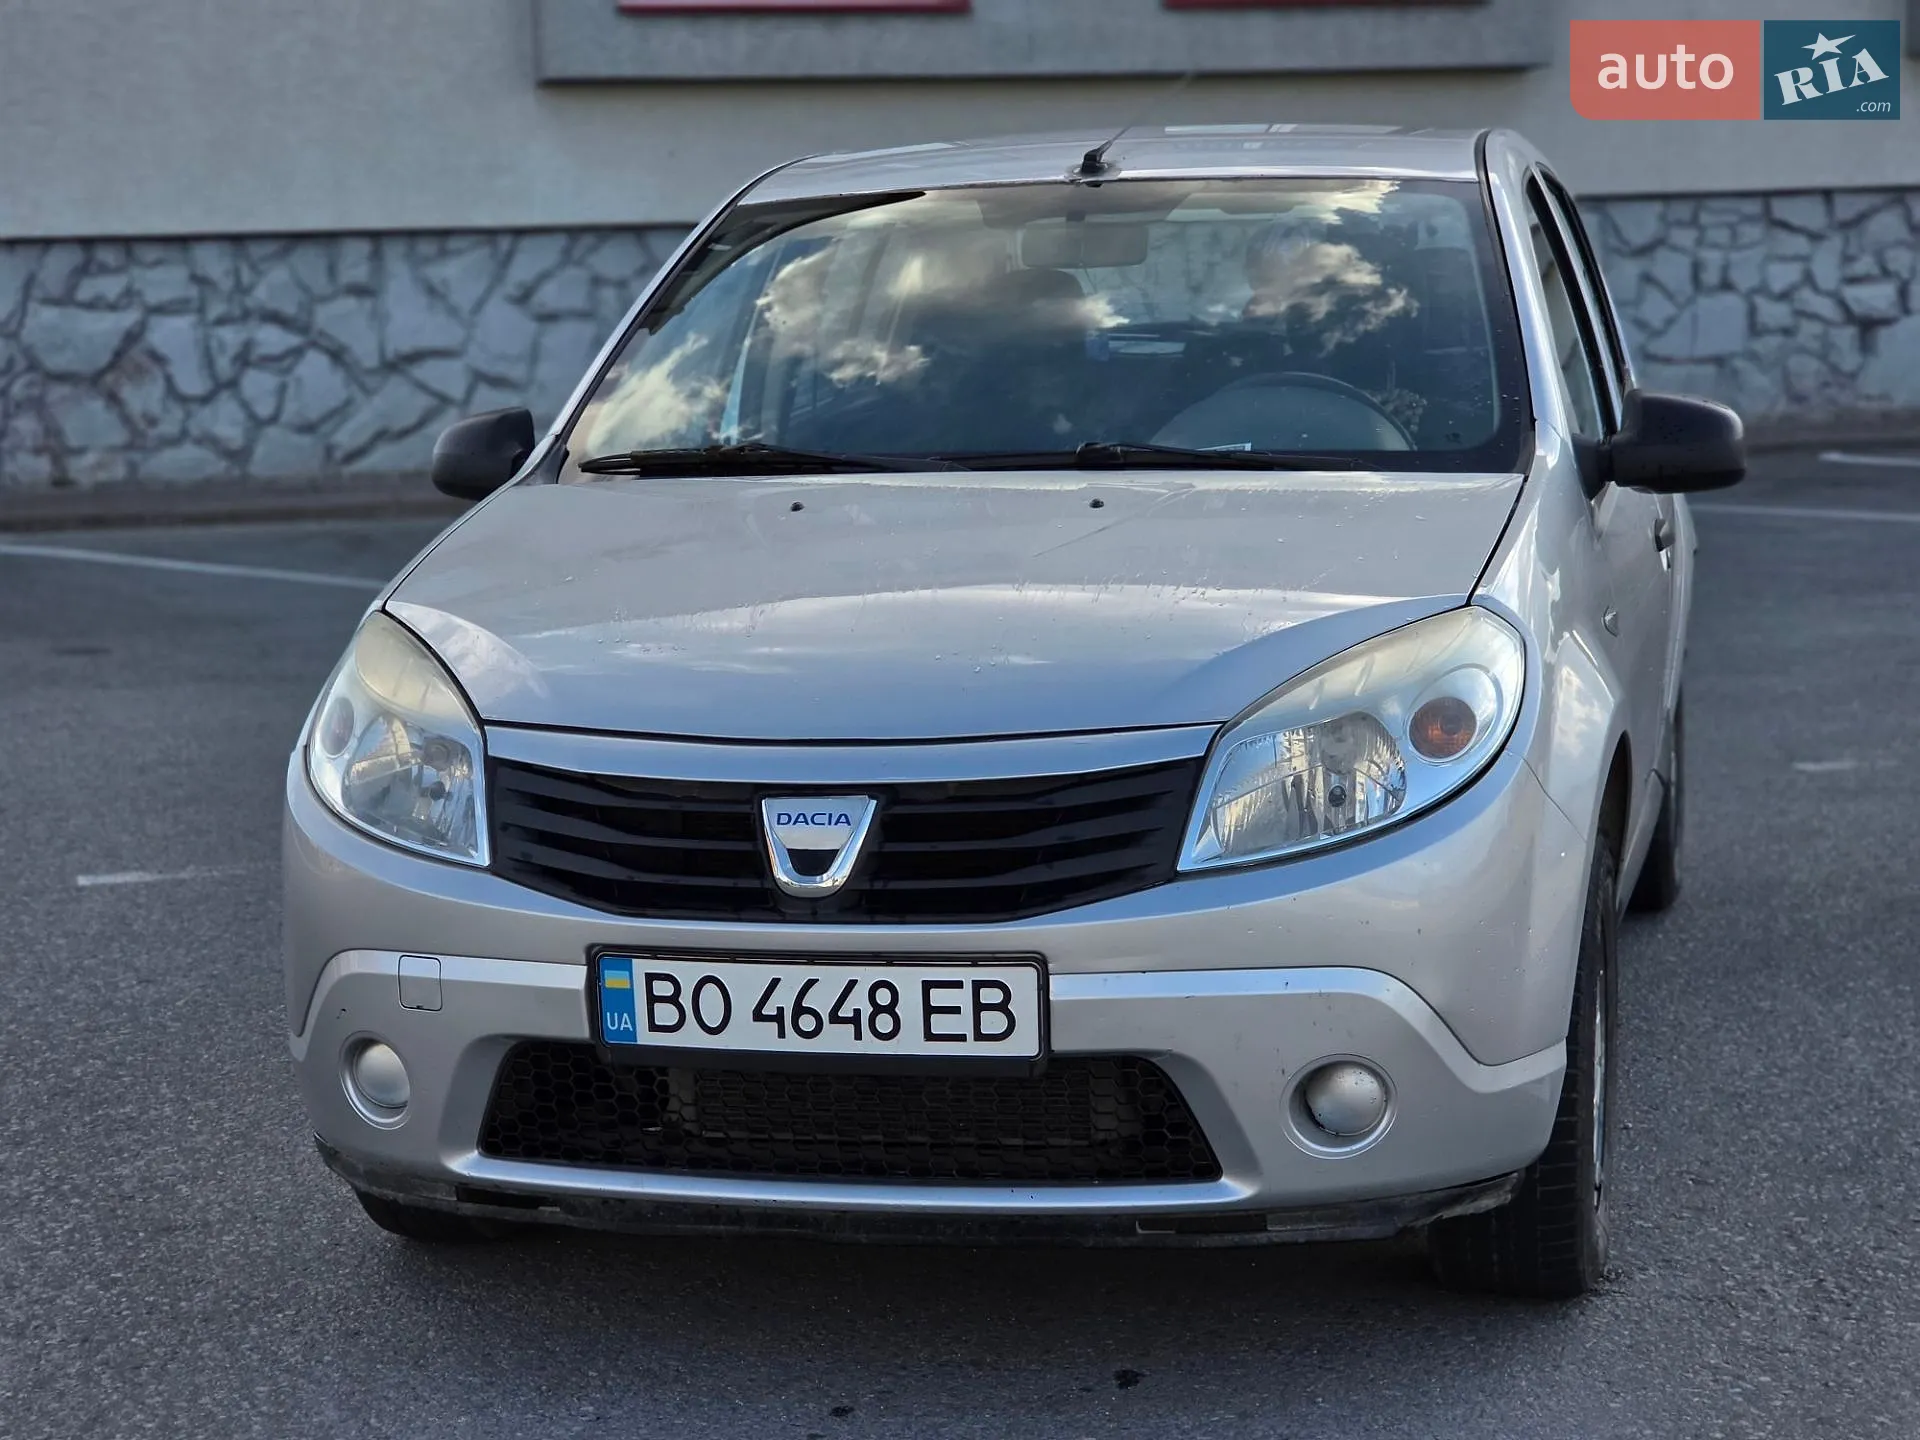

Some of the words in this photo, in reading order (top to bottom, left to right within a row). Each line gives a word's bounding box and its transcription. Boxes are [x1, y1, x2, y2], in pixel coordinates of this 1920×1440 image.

[776, 812, 851, 826] DACIA
[752, 977, 902, 1041] 4648
[921, 979, 1016, 1042] EB
[607, 1012, 633, 1032] UA
